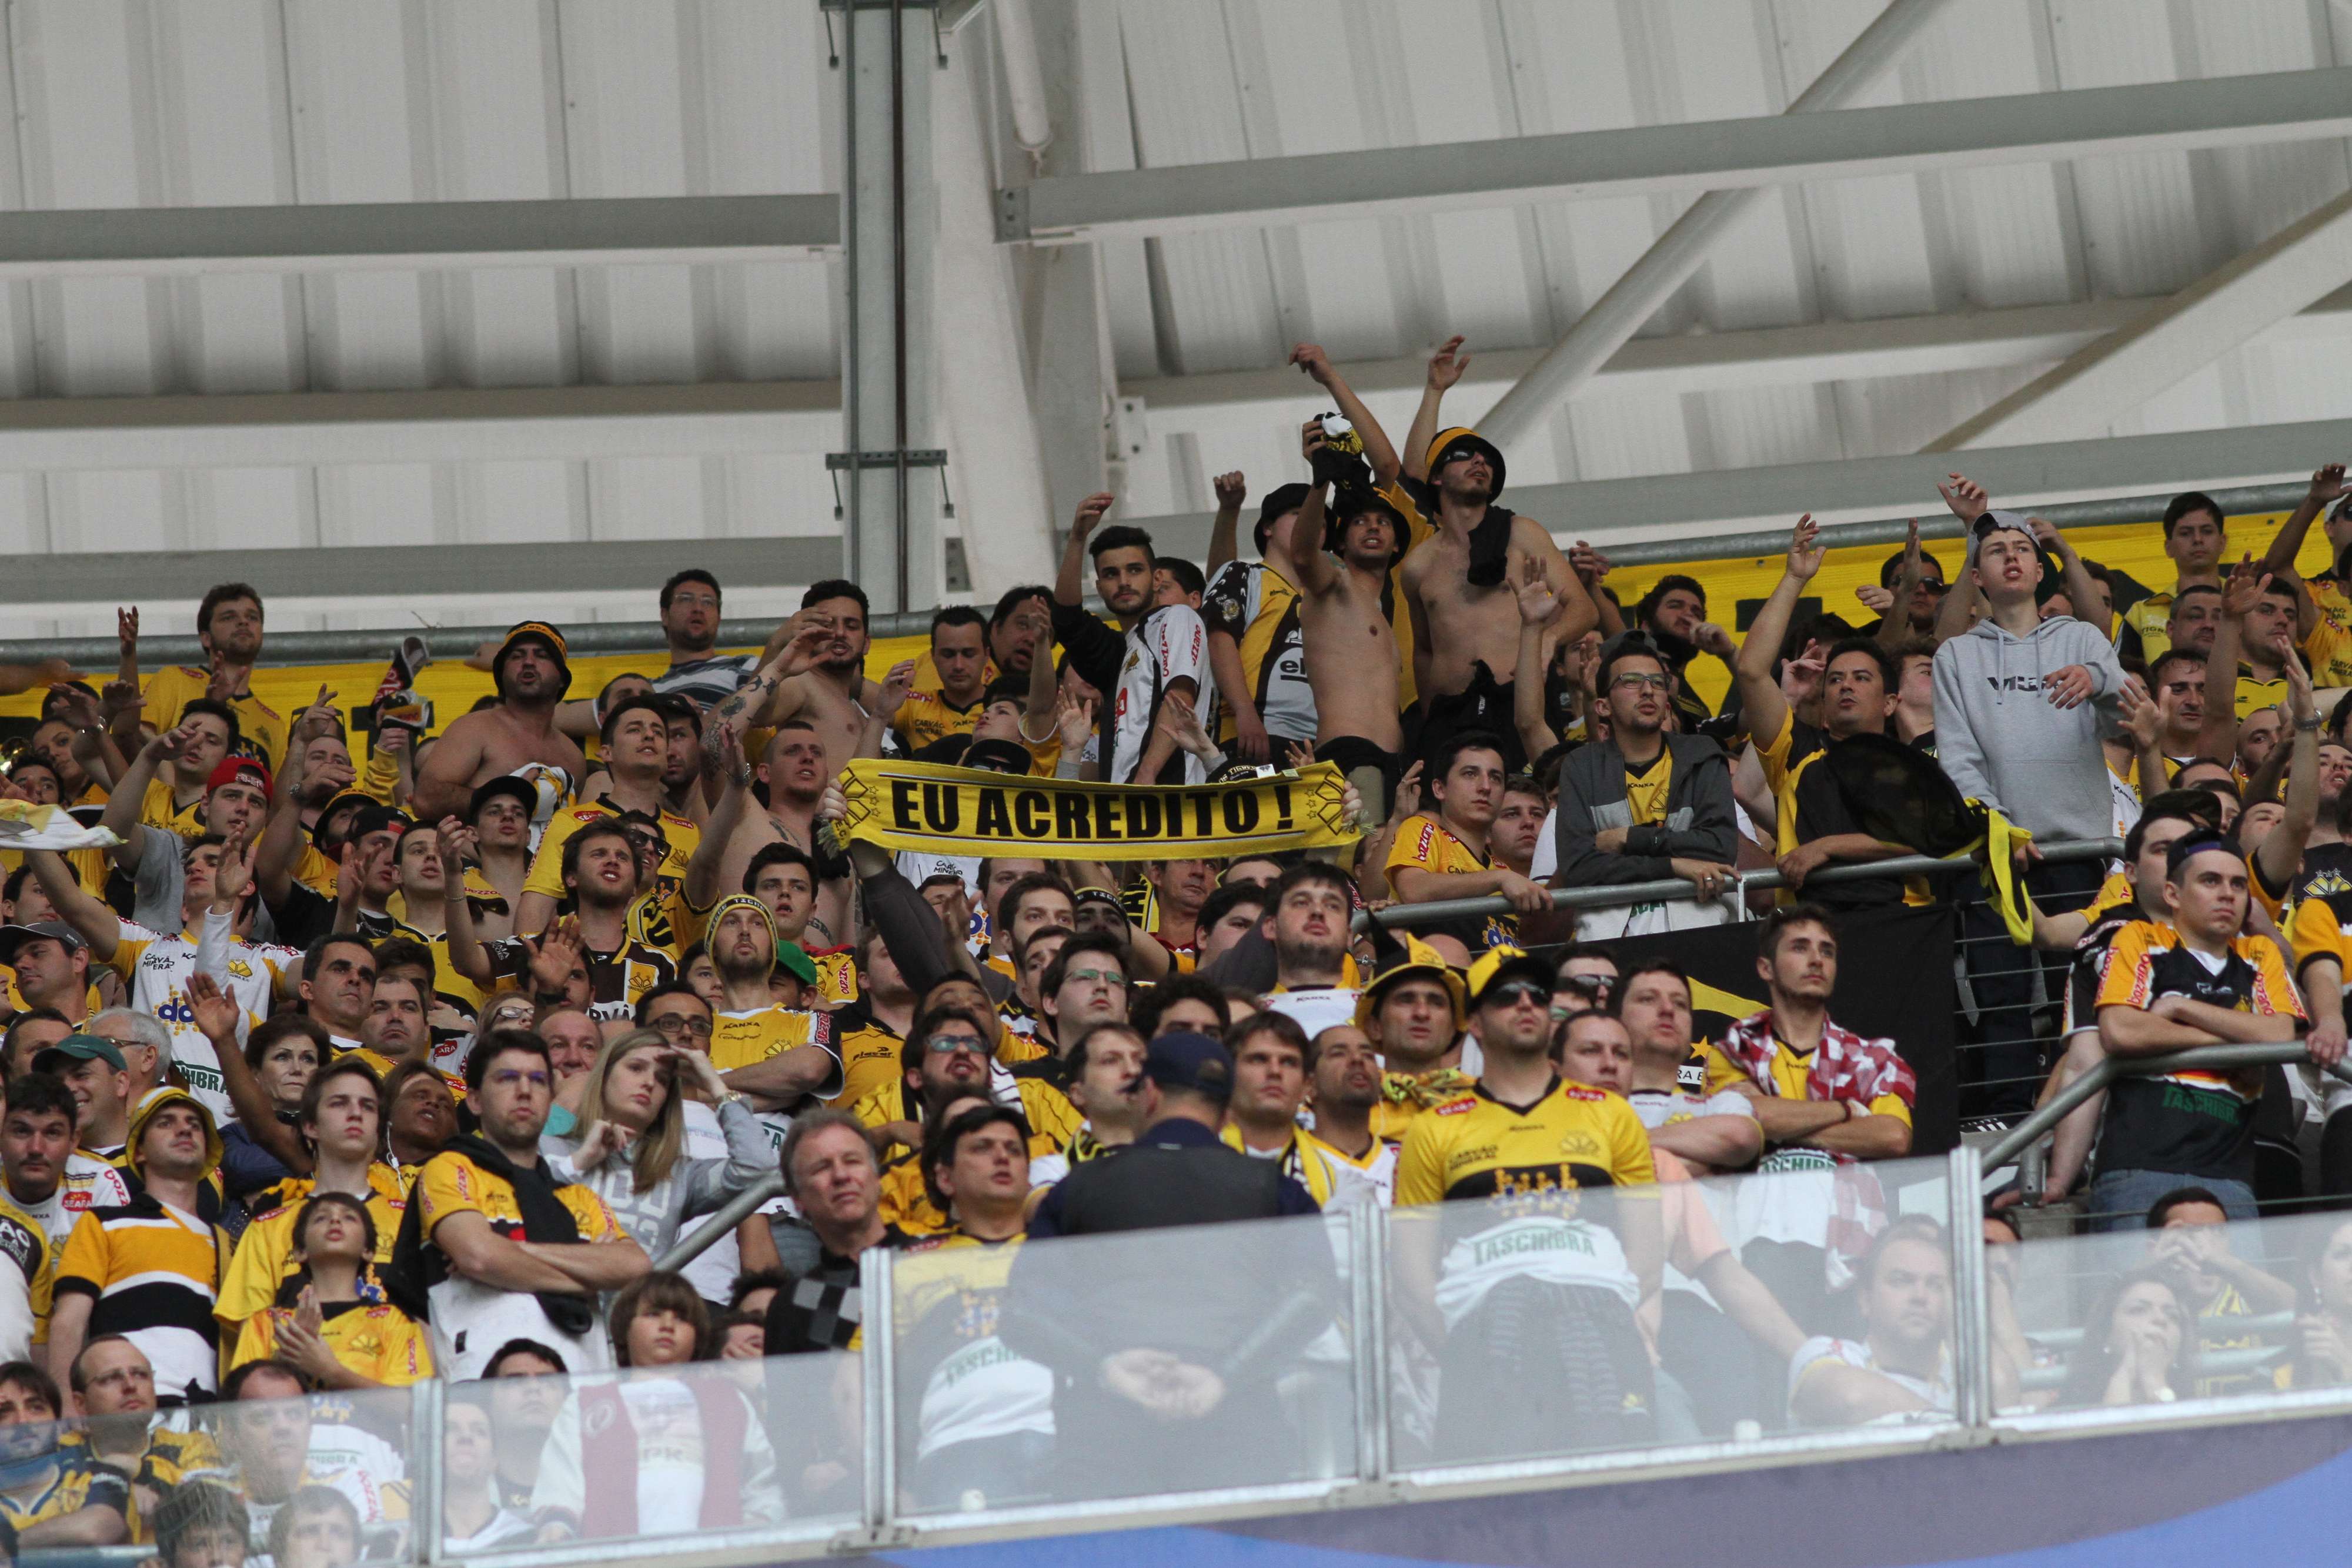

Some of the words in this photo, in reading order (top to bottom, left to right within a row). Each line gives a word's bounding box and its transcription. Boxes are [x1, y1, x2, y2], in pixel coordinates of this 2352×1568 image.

[892, 781, 959, 832] EU
[976, 789, 1260, 838] ACREDITO
[1277, 785, 1294, 829] !
[64, 1199, 92, 1209] SEARA
[104, 1169, 130, 1207] bozz
[1474, 1230, 1596, 1266] TASCHIBRA
